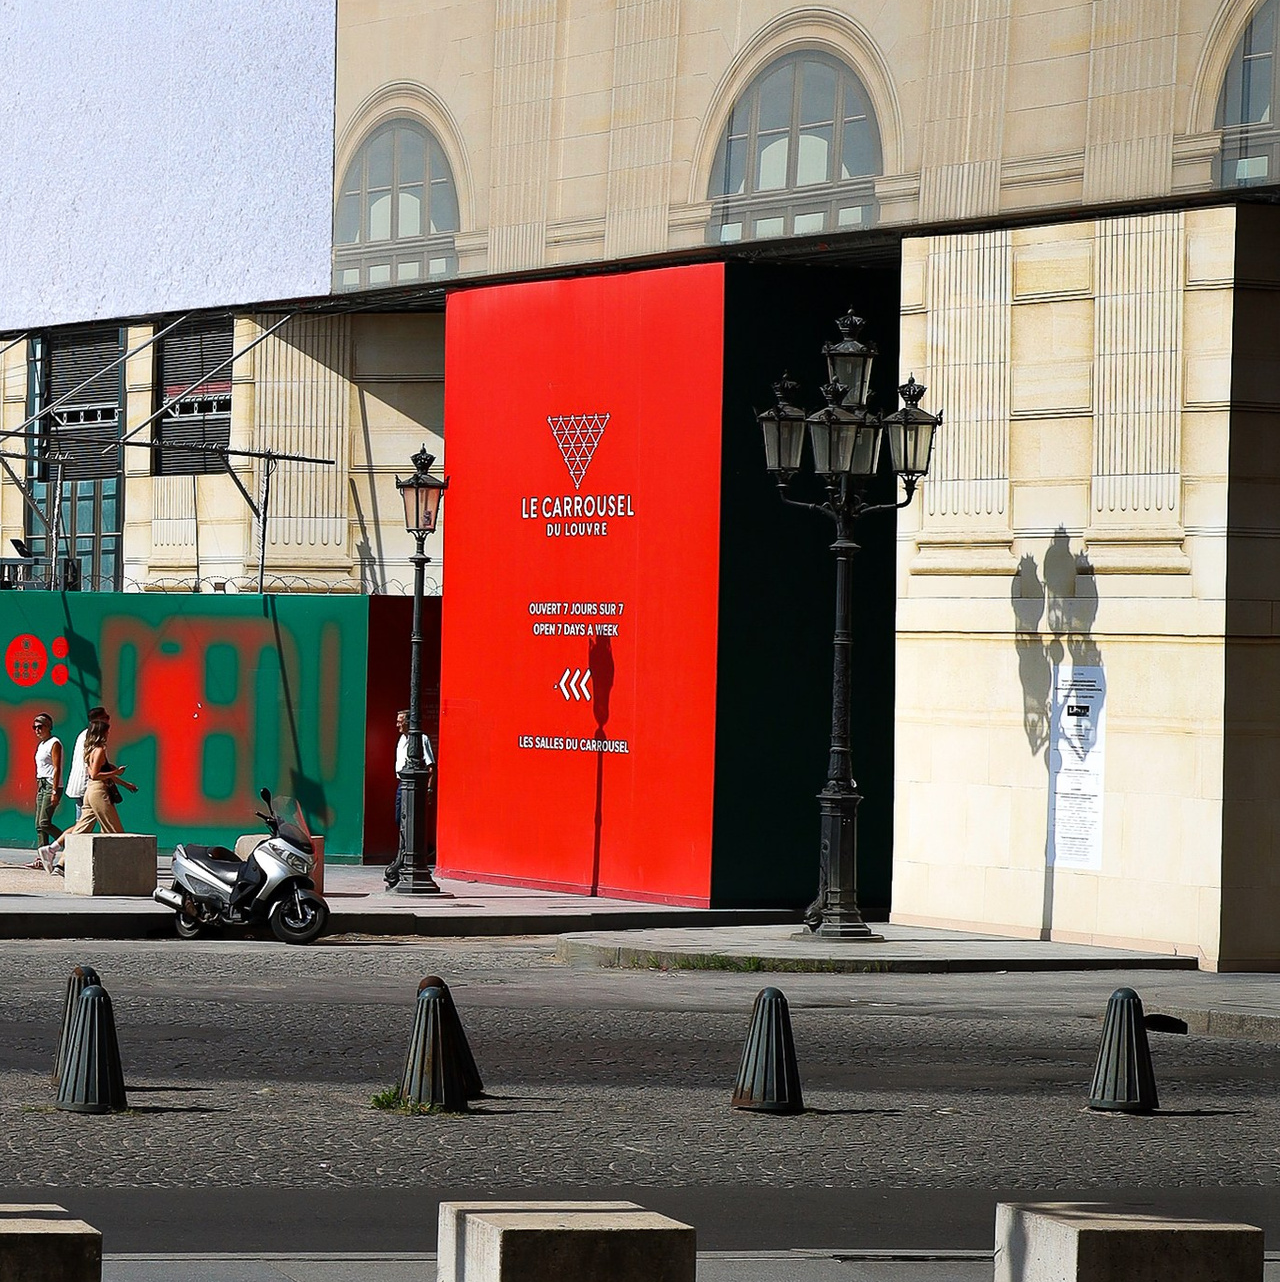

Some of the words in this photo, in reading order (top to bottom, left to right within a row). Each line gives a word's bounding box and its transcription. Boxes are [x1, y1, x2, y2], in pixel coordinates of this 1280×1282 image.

[521, 497, 538, 518] LE
[541, 494, 634, 518] CARROUSEL
[546, 523, 561, 536] DU
[565, 522, 608, 536] LOUVRE
[528, 602, 562, 615] OUVERT
[562, 603, 569, 615] 7
[570, 603, 598, 615] JOURS
[599, 603, 617, 615] SUR
[618, 603, 624, 615] 7
[532, 623, 555, 636] OPEN
[556, 624, 562, 635] 7
[563, 623, 586, 636] DAYS
[587, 624, 594, 636] A
[595, 624, 619, 636] WEEK
[519, 736, 534, 748] LES
[535, 737, 564, 750] SALLES
[565, 738, 578, 750] DU
[580, 739, 630, 753] CARROUSEL
